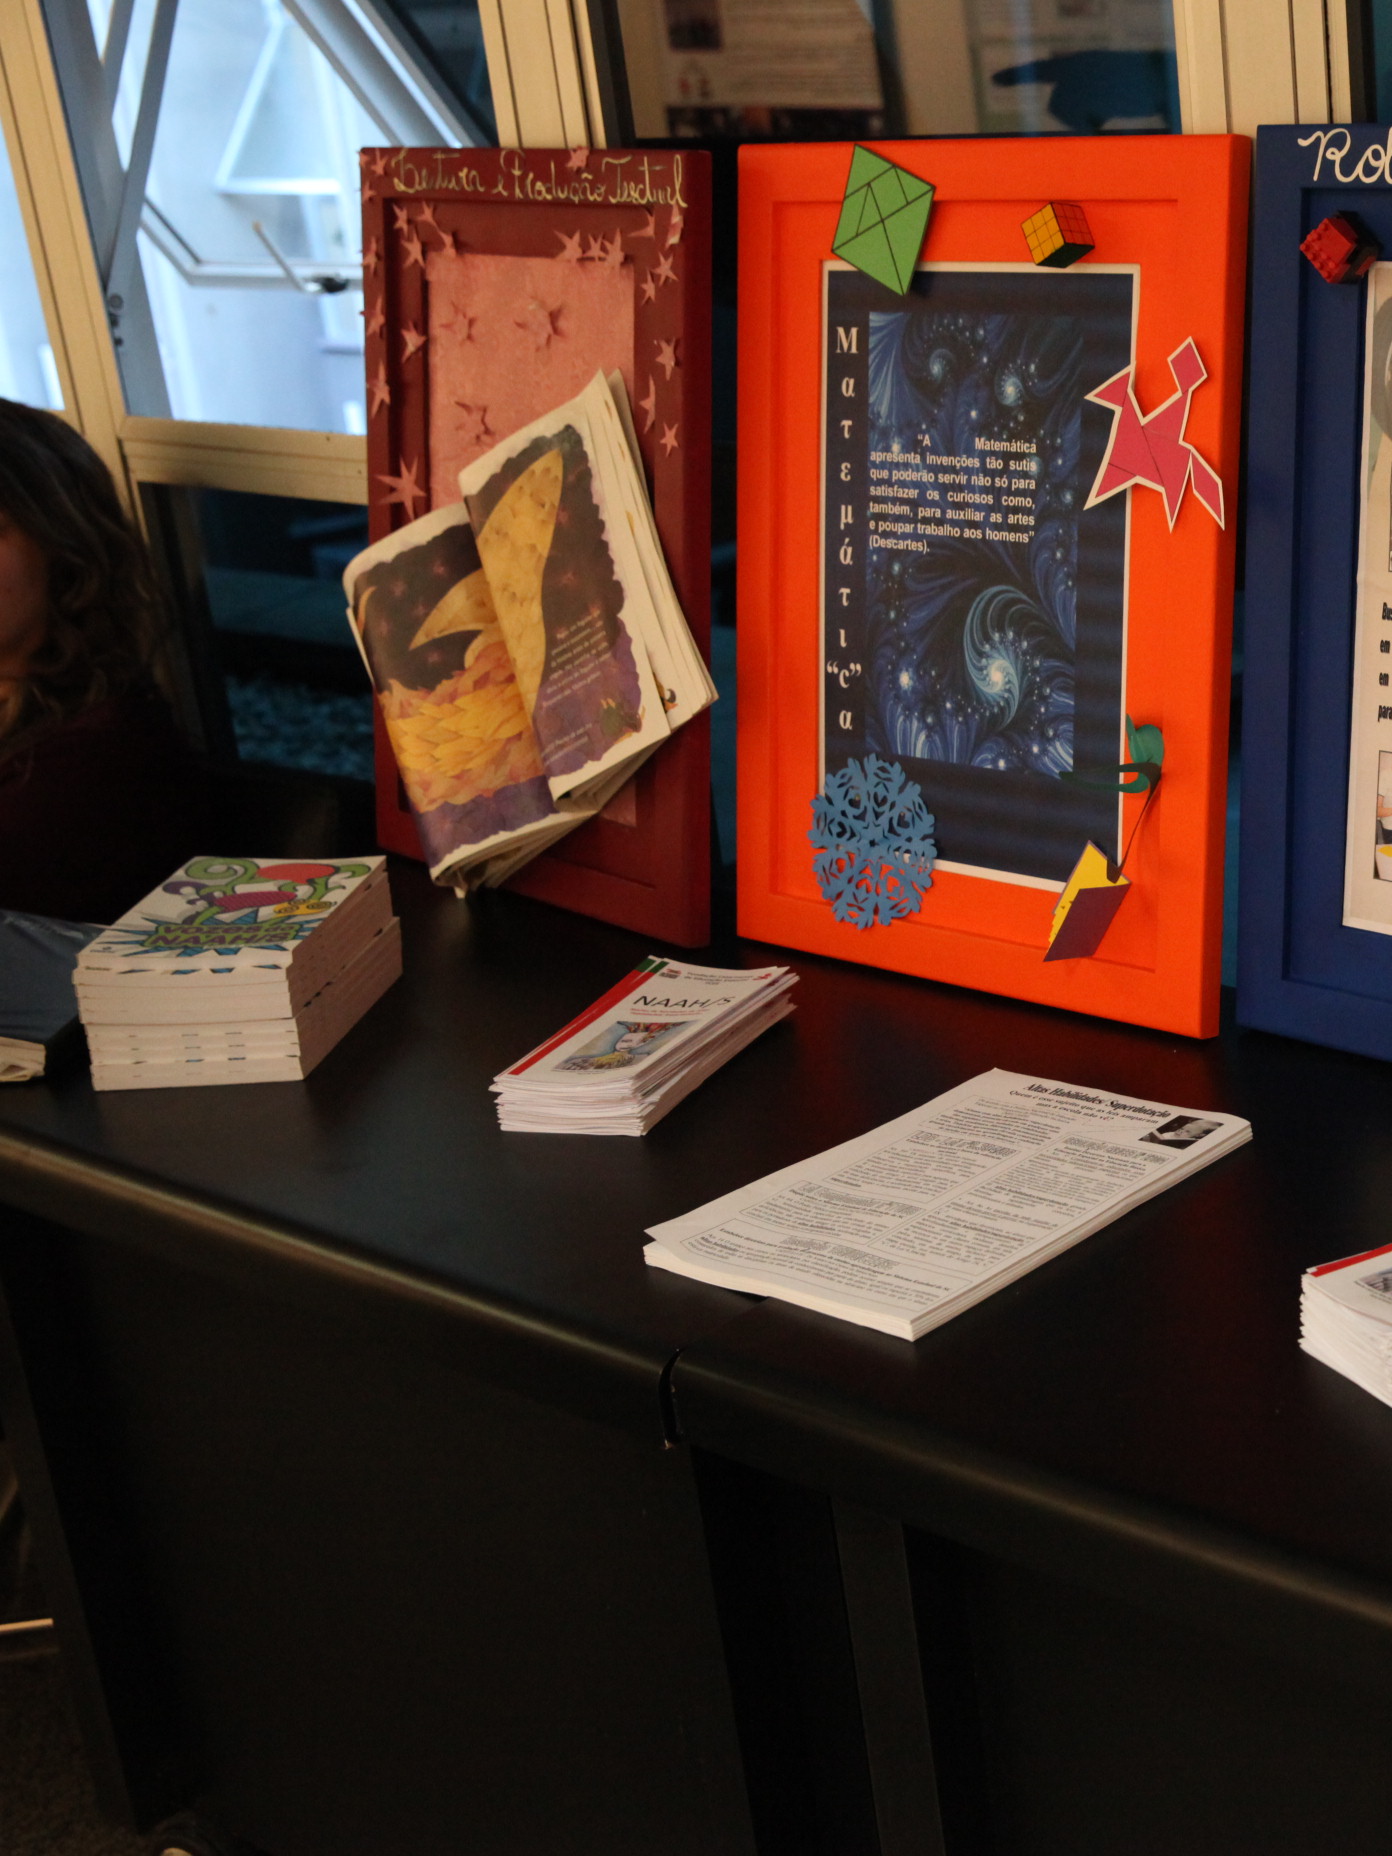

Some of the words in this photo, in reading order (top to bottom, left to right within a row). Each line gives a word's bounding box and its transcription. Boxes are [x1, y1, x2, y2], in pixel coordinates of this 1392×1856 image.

[975, 437, 1036, 453] Matemática
[870, 451, 920, 464] apresenta
[927, 452, 979, 469] invenções
[986, 455, 1002, 469] tão
[1010, 456, 1036, 471] sutis
[870, 469, 888, 481] que
[892, 469, 934, 483] poderão
[938, 472, 968, 484] servir
[971, 473, 991, 486] não
[995, 474, 1008, 487] só
[1012, 477, 1035, 489] para
[870, 484, 918, 498] satisfazer
[927, 489, 939, 500] os
[947, 490, 993, 504] curiosos
[1002, 495, 1035, 509] como,
[869, 501, 913, 517] também,
[918, 506, 941, 519] para
[946, 505, 985, 521] auxiliar
[990, 510, 1002, 522] as
[1008, 511, 1034, 525] artes
[869, 521, 875, 530] e
[878, 522, 914, 536] poupar
[917, 522, 960, 537] trabalho
[963, 528, 982, 539] aos
[869, 535, 930, 552] (Descartes).
[1380, 639, 1390, 653] em
[1379, 672, 1389, 686] em
[1378, 704, 1392, 722] para
[633, 996, 736, 1008] NAAH/S
[1023, 1083, 1050, 1093] Altas
[1106, 1100, 1171, 1118] Superdotação
